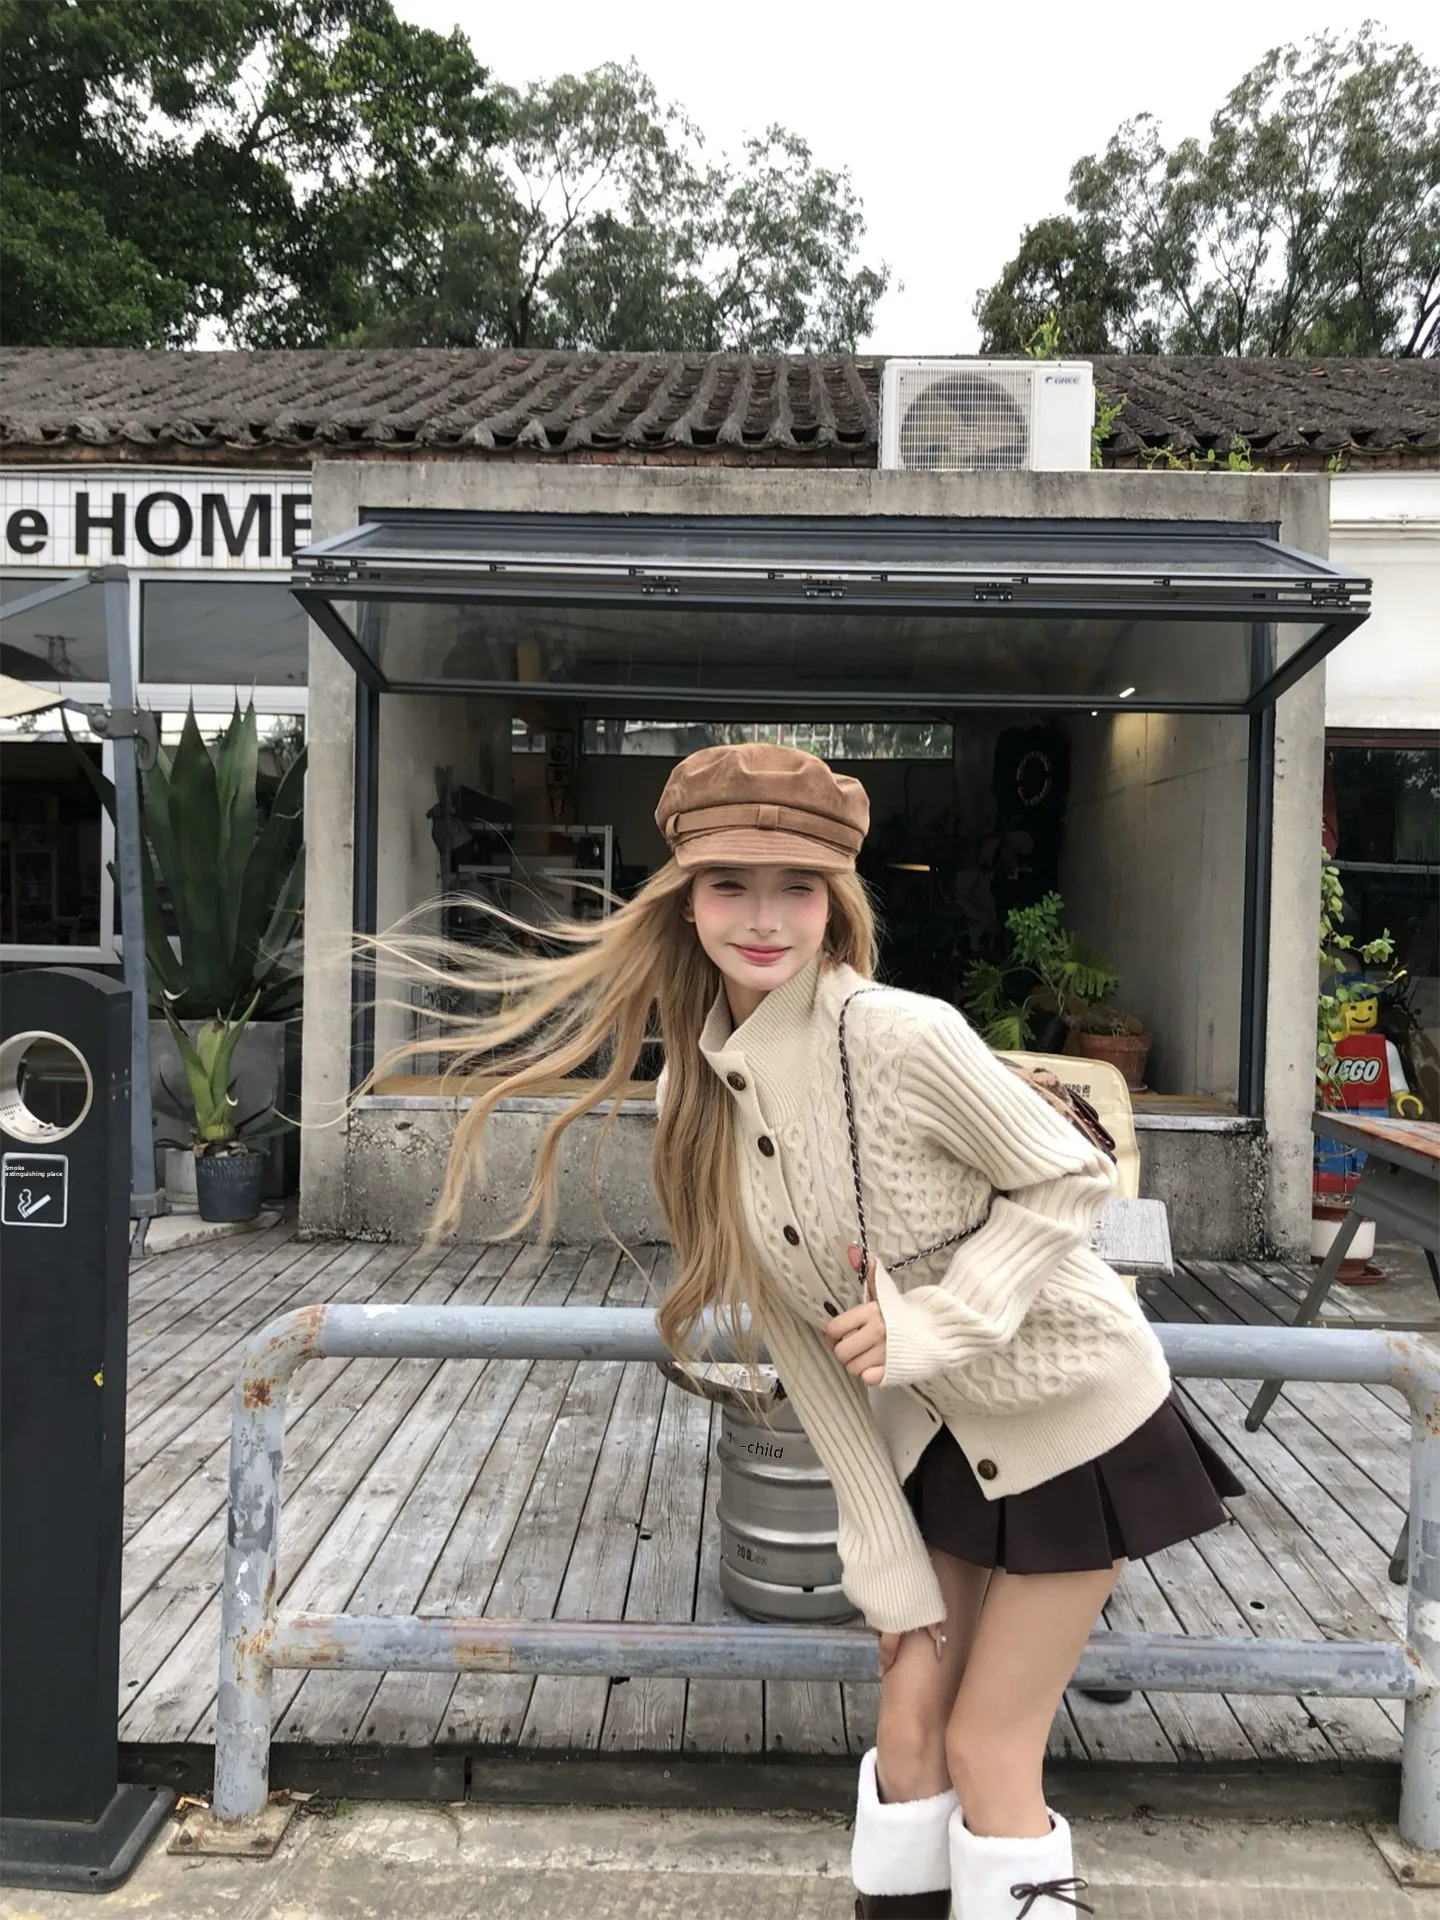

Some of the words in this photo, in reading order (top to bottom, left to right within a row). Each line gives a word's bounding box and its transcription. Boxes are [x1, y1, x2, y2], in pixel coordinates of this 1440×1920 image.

[6, 508, 49, 554] e
[75, 491, 312, 557] HOME
[1328, 1058, 1381, 1082] LEGO
